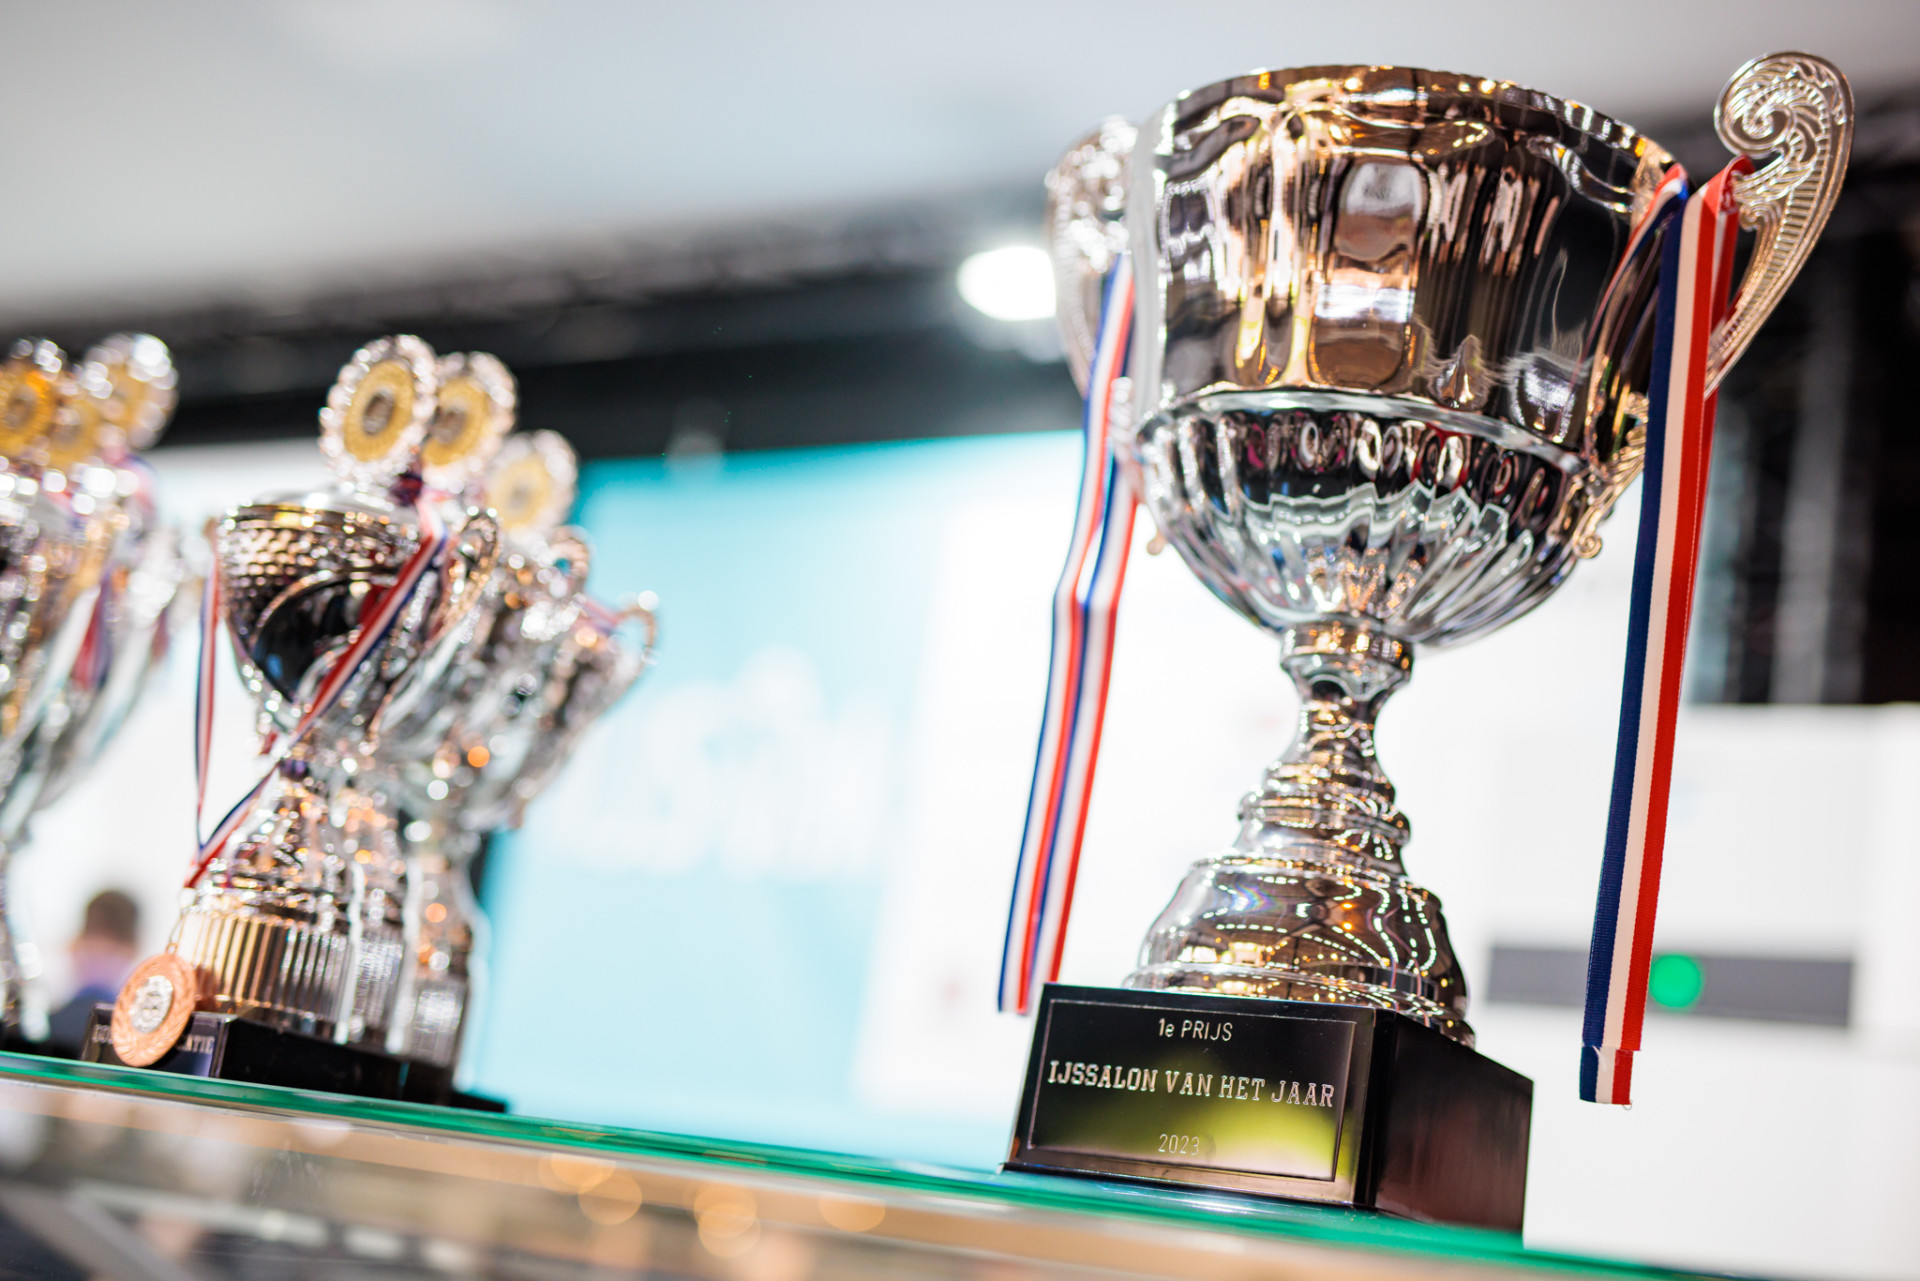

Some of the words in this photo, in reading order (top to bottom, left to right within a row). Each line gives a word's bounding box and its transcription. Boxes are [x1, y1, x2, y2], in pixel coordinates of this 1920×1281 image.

[1158, 1017, 1175, 1038] 1e
[1180, 1019, 1233, 1042] PRIJS
[1047, 1059, 1158, 1092] IJSSALON
[1165, 1070, 1213, 1097] VAN
[1218, 1075, 1266, 1101] HET
[1271, 1080, 1335, 1107] JAAR
[1158, 1133, 1201, 1156] 2023
